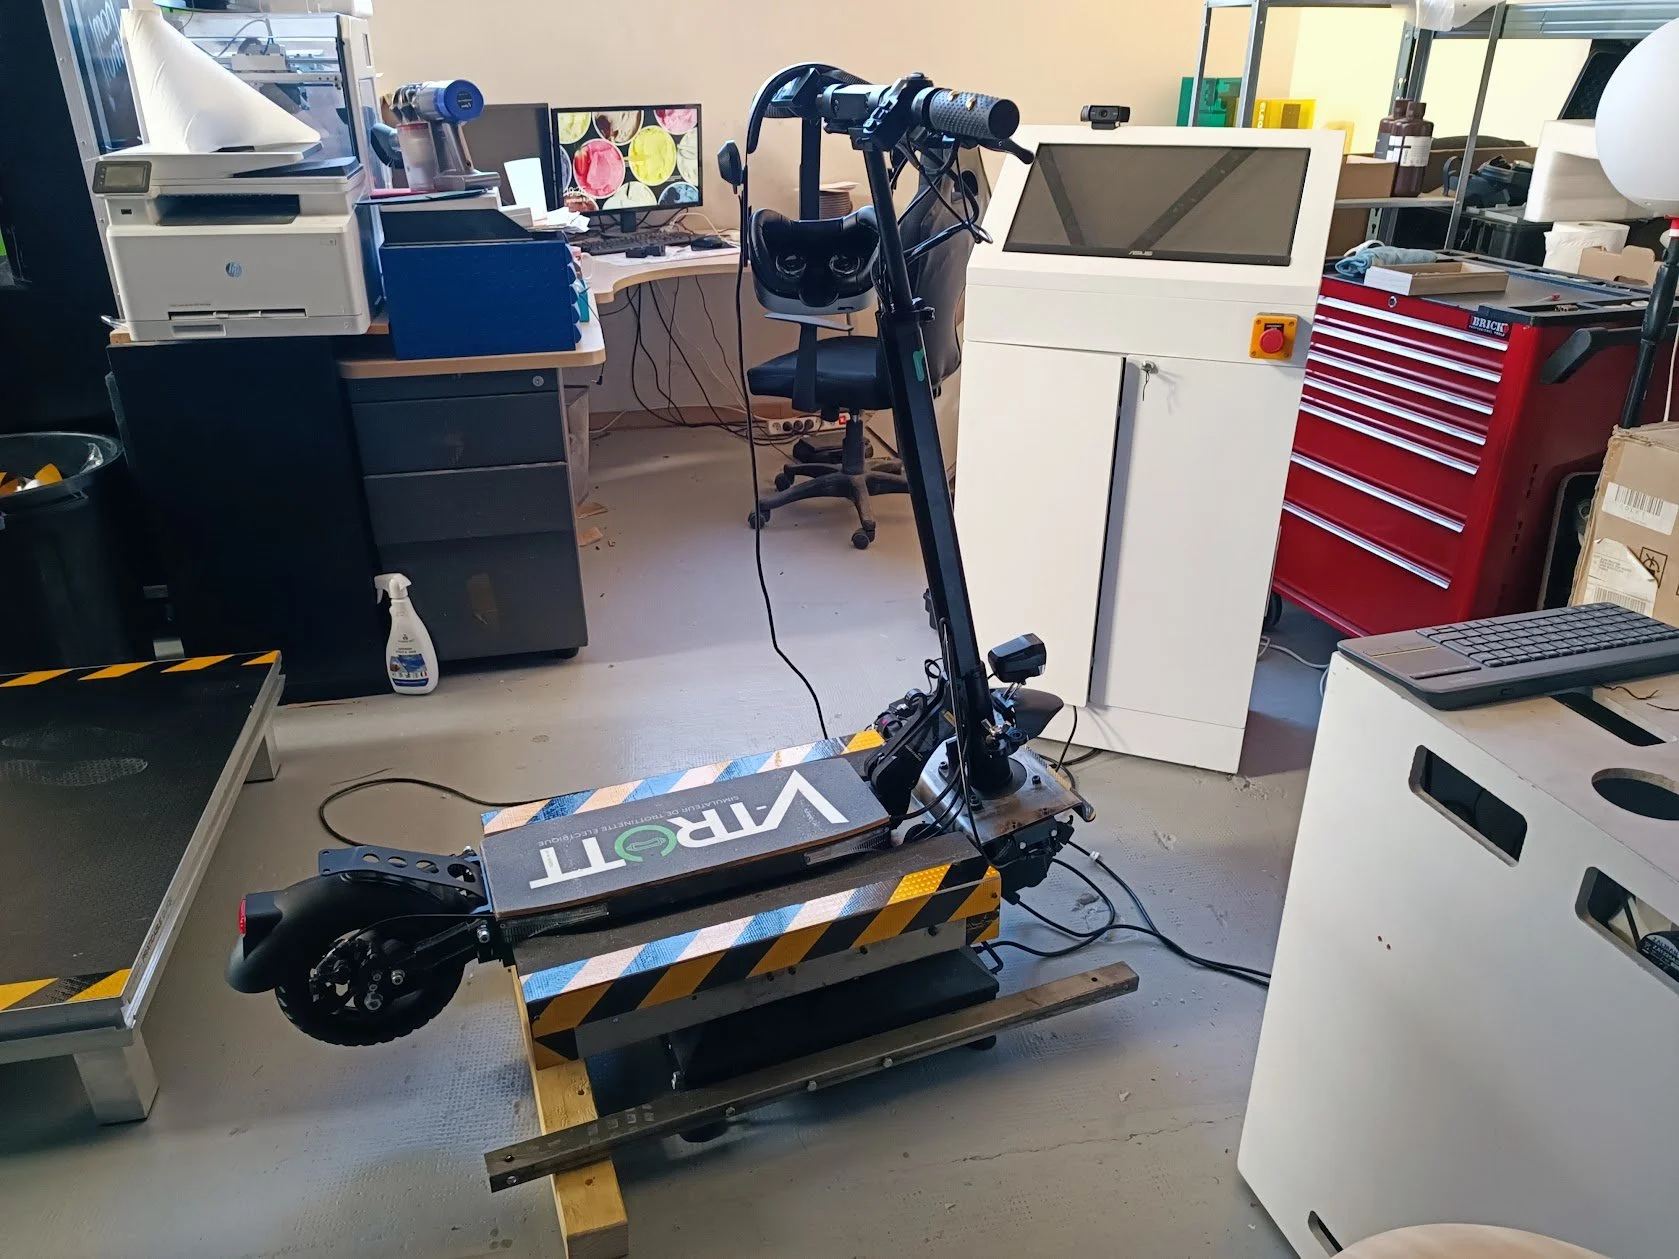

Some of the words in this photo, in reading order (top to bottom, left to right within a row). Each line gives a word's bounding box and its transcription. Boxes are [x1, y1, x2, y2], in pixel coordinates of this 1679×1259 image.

[1472, 316, 1508, 333] BRICK
[665, 808, 681, 818] DE
[682, 795, 741, 814] SIMULATEUR
[601, 813, 664, 831] TROTTINETTE
